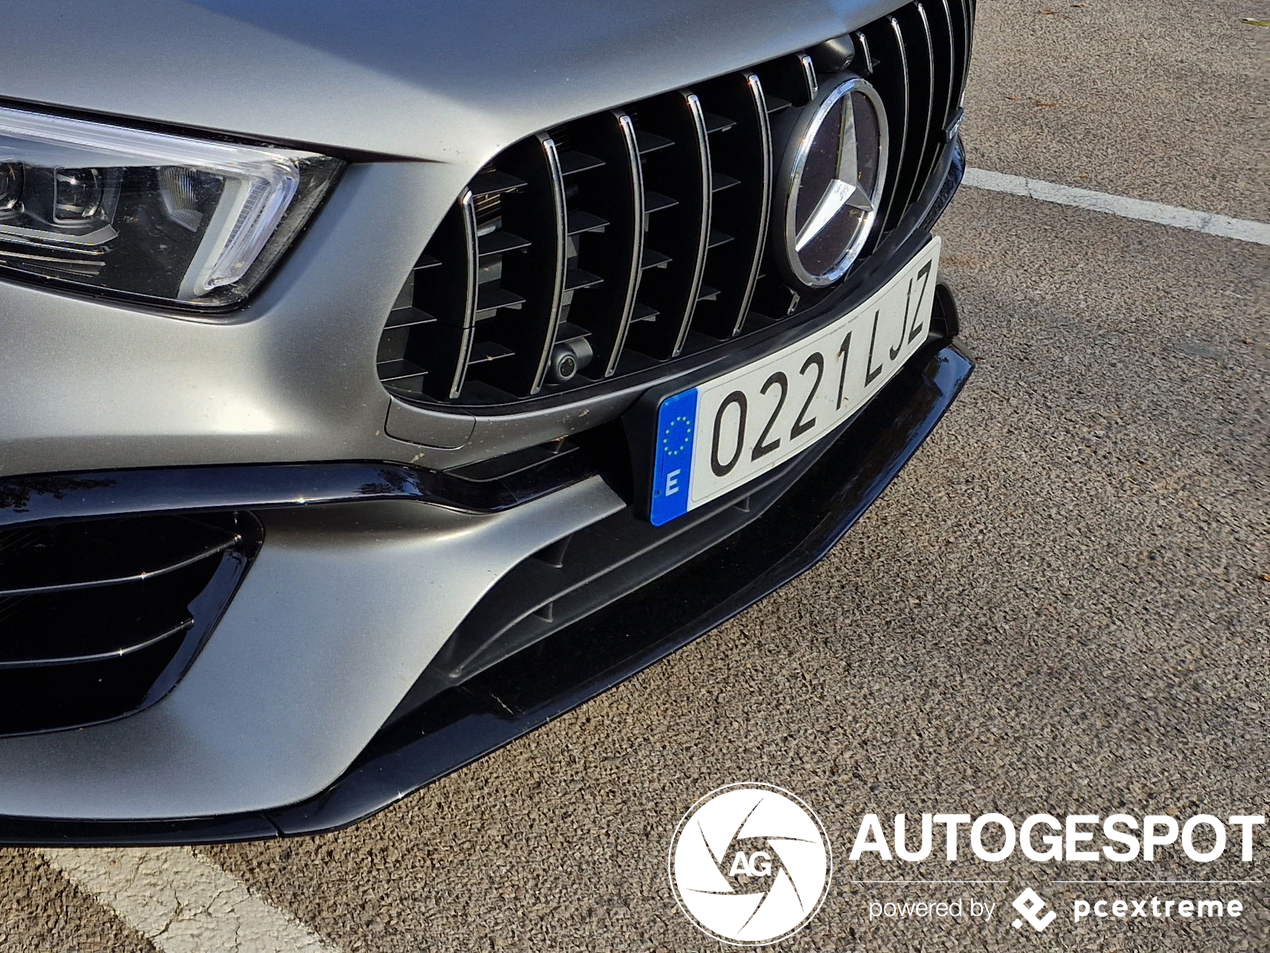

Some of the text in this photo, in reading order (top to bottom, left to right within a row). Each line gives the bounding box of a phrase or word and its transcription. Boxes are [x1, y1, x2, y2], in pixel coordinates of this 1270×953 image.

[710, 258, 933, 478] 0221 LJZ
[664, 468, 681, 497] E
